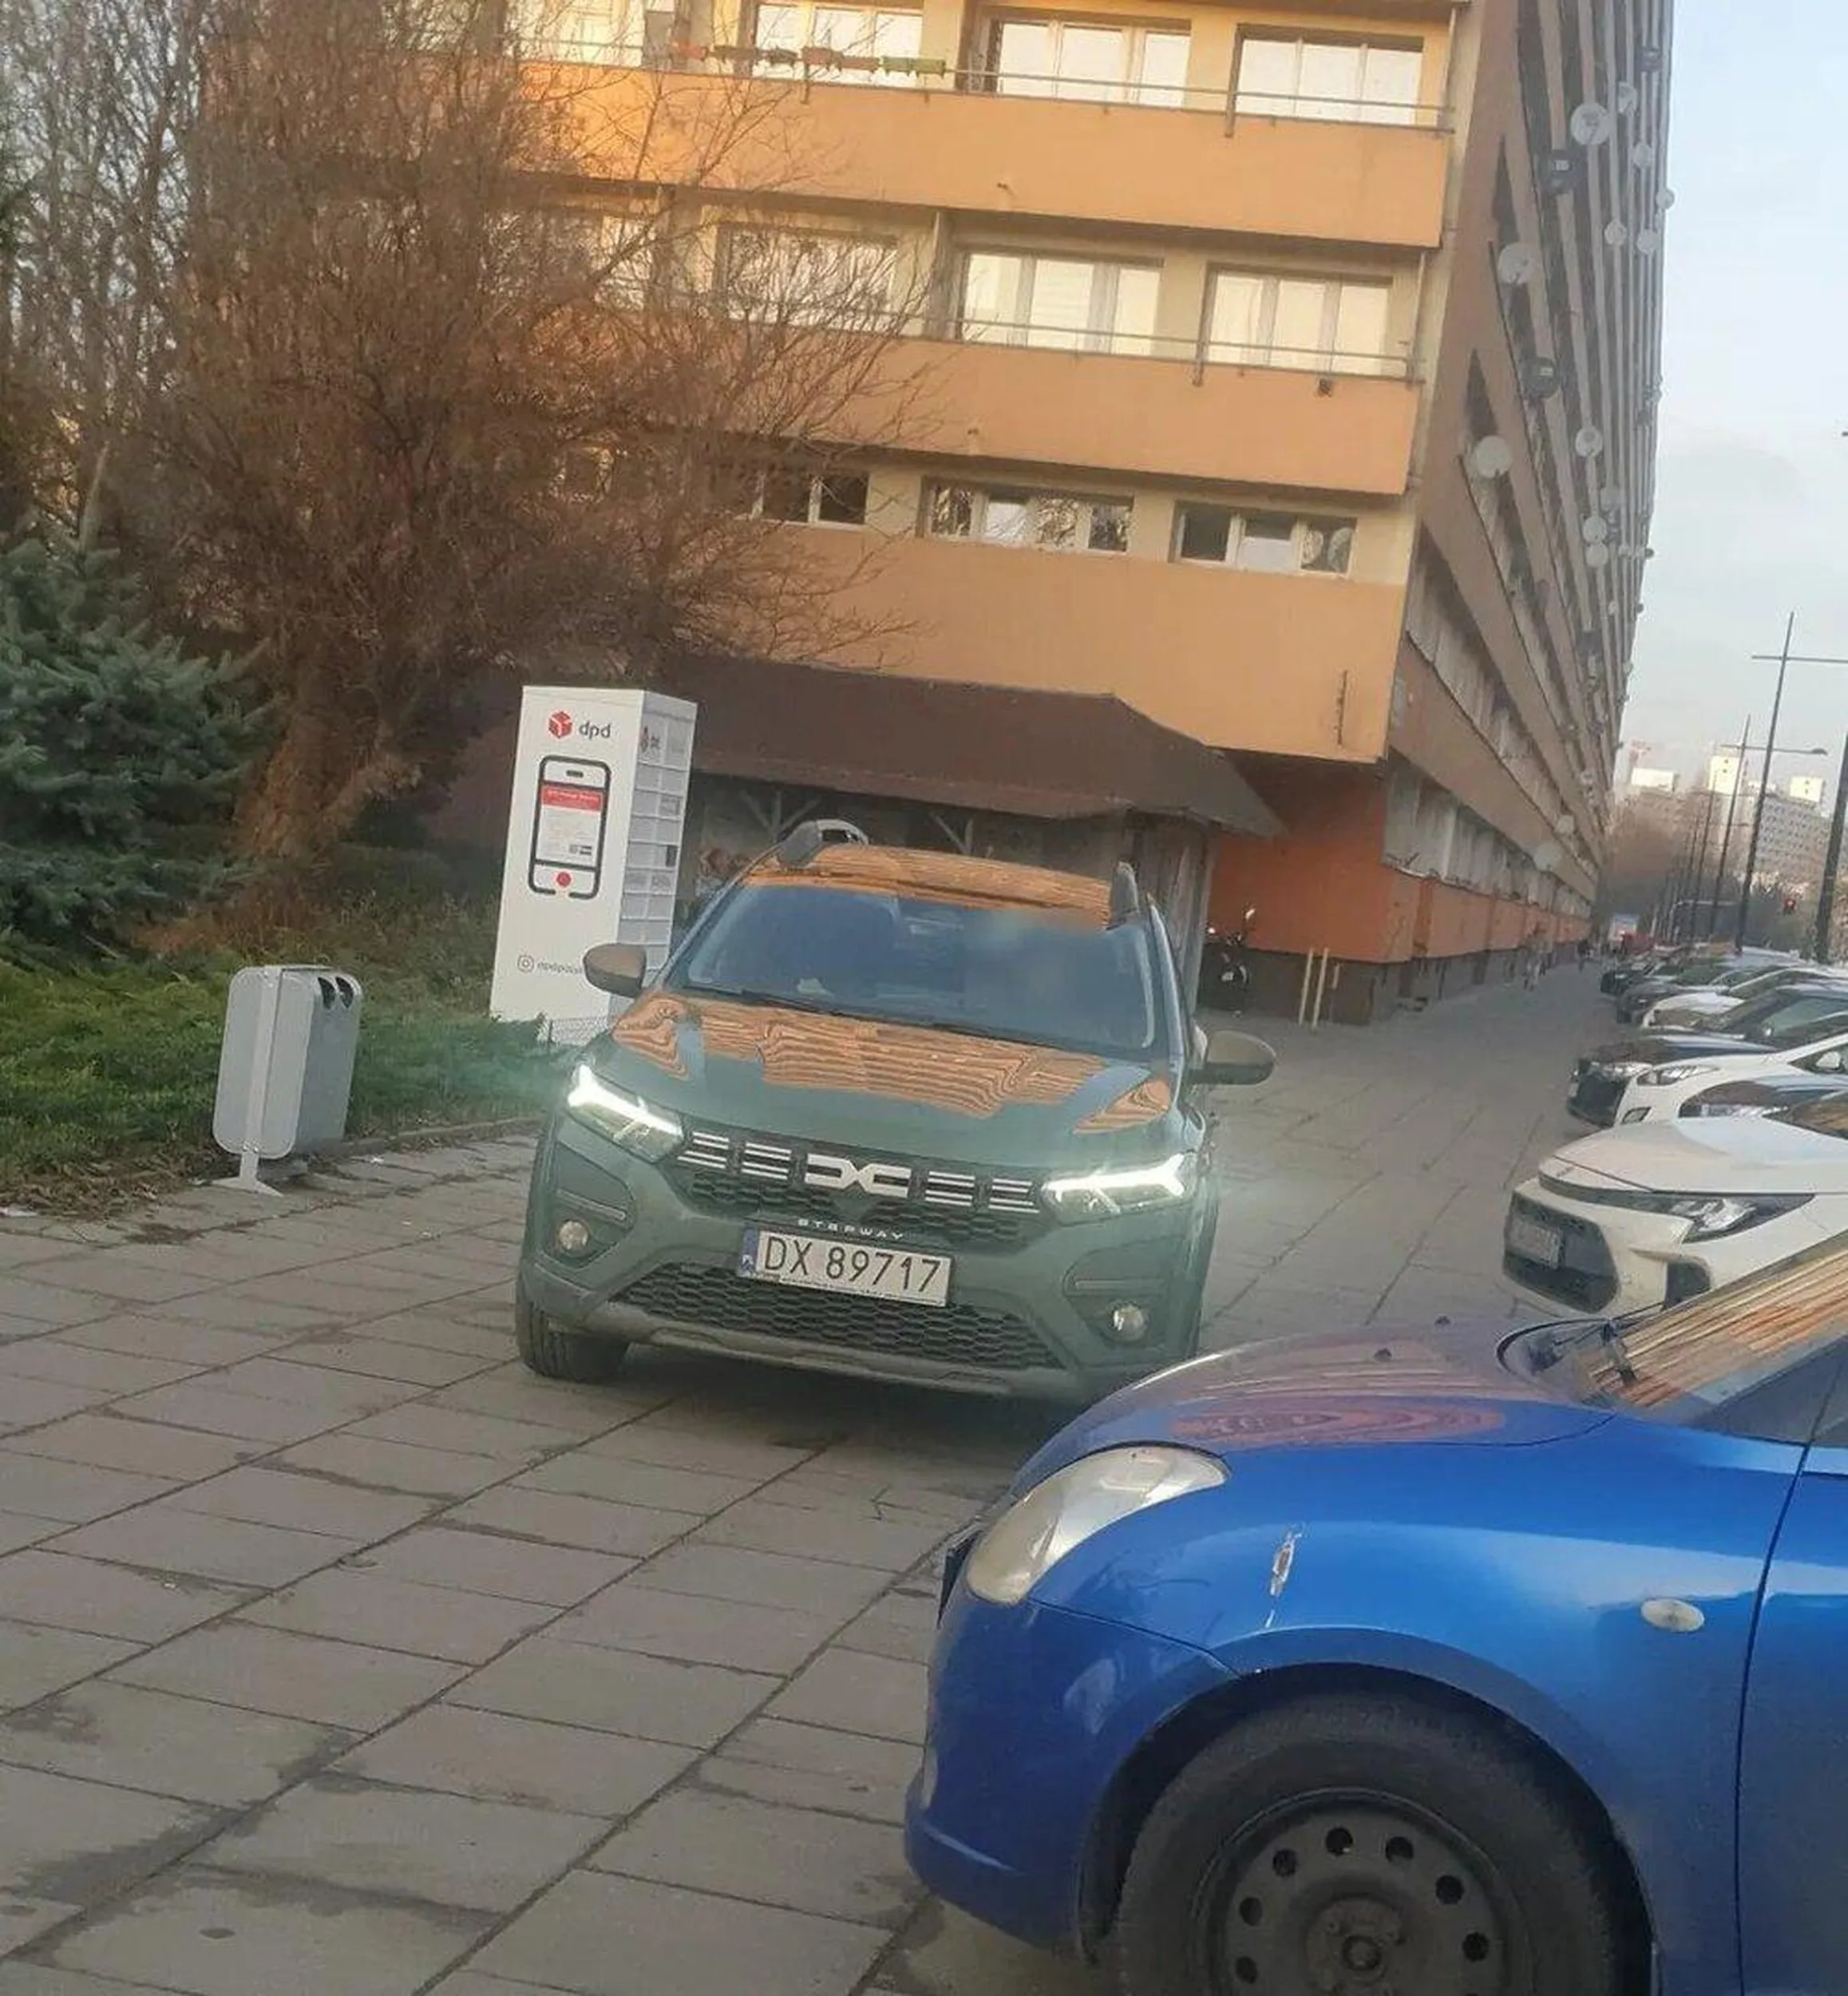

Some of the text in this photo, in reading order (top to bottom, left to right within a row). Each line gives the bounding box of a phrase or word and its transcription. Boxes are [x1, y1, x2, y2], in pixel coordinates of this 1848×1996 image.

[578, 721, 611, 741] dpd
[764, 1236, 813, 1276] DX
[825, 1246, 941, 1293] 89717
